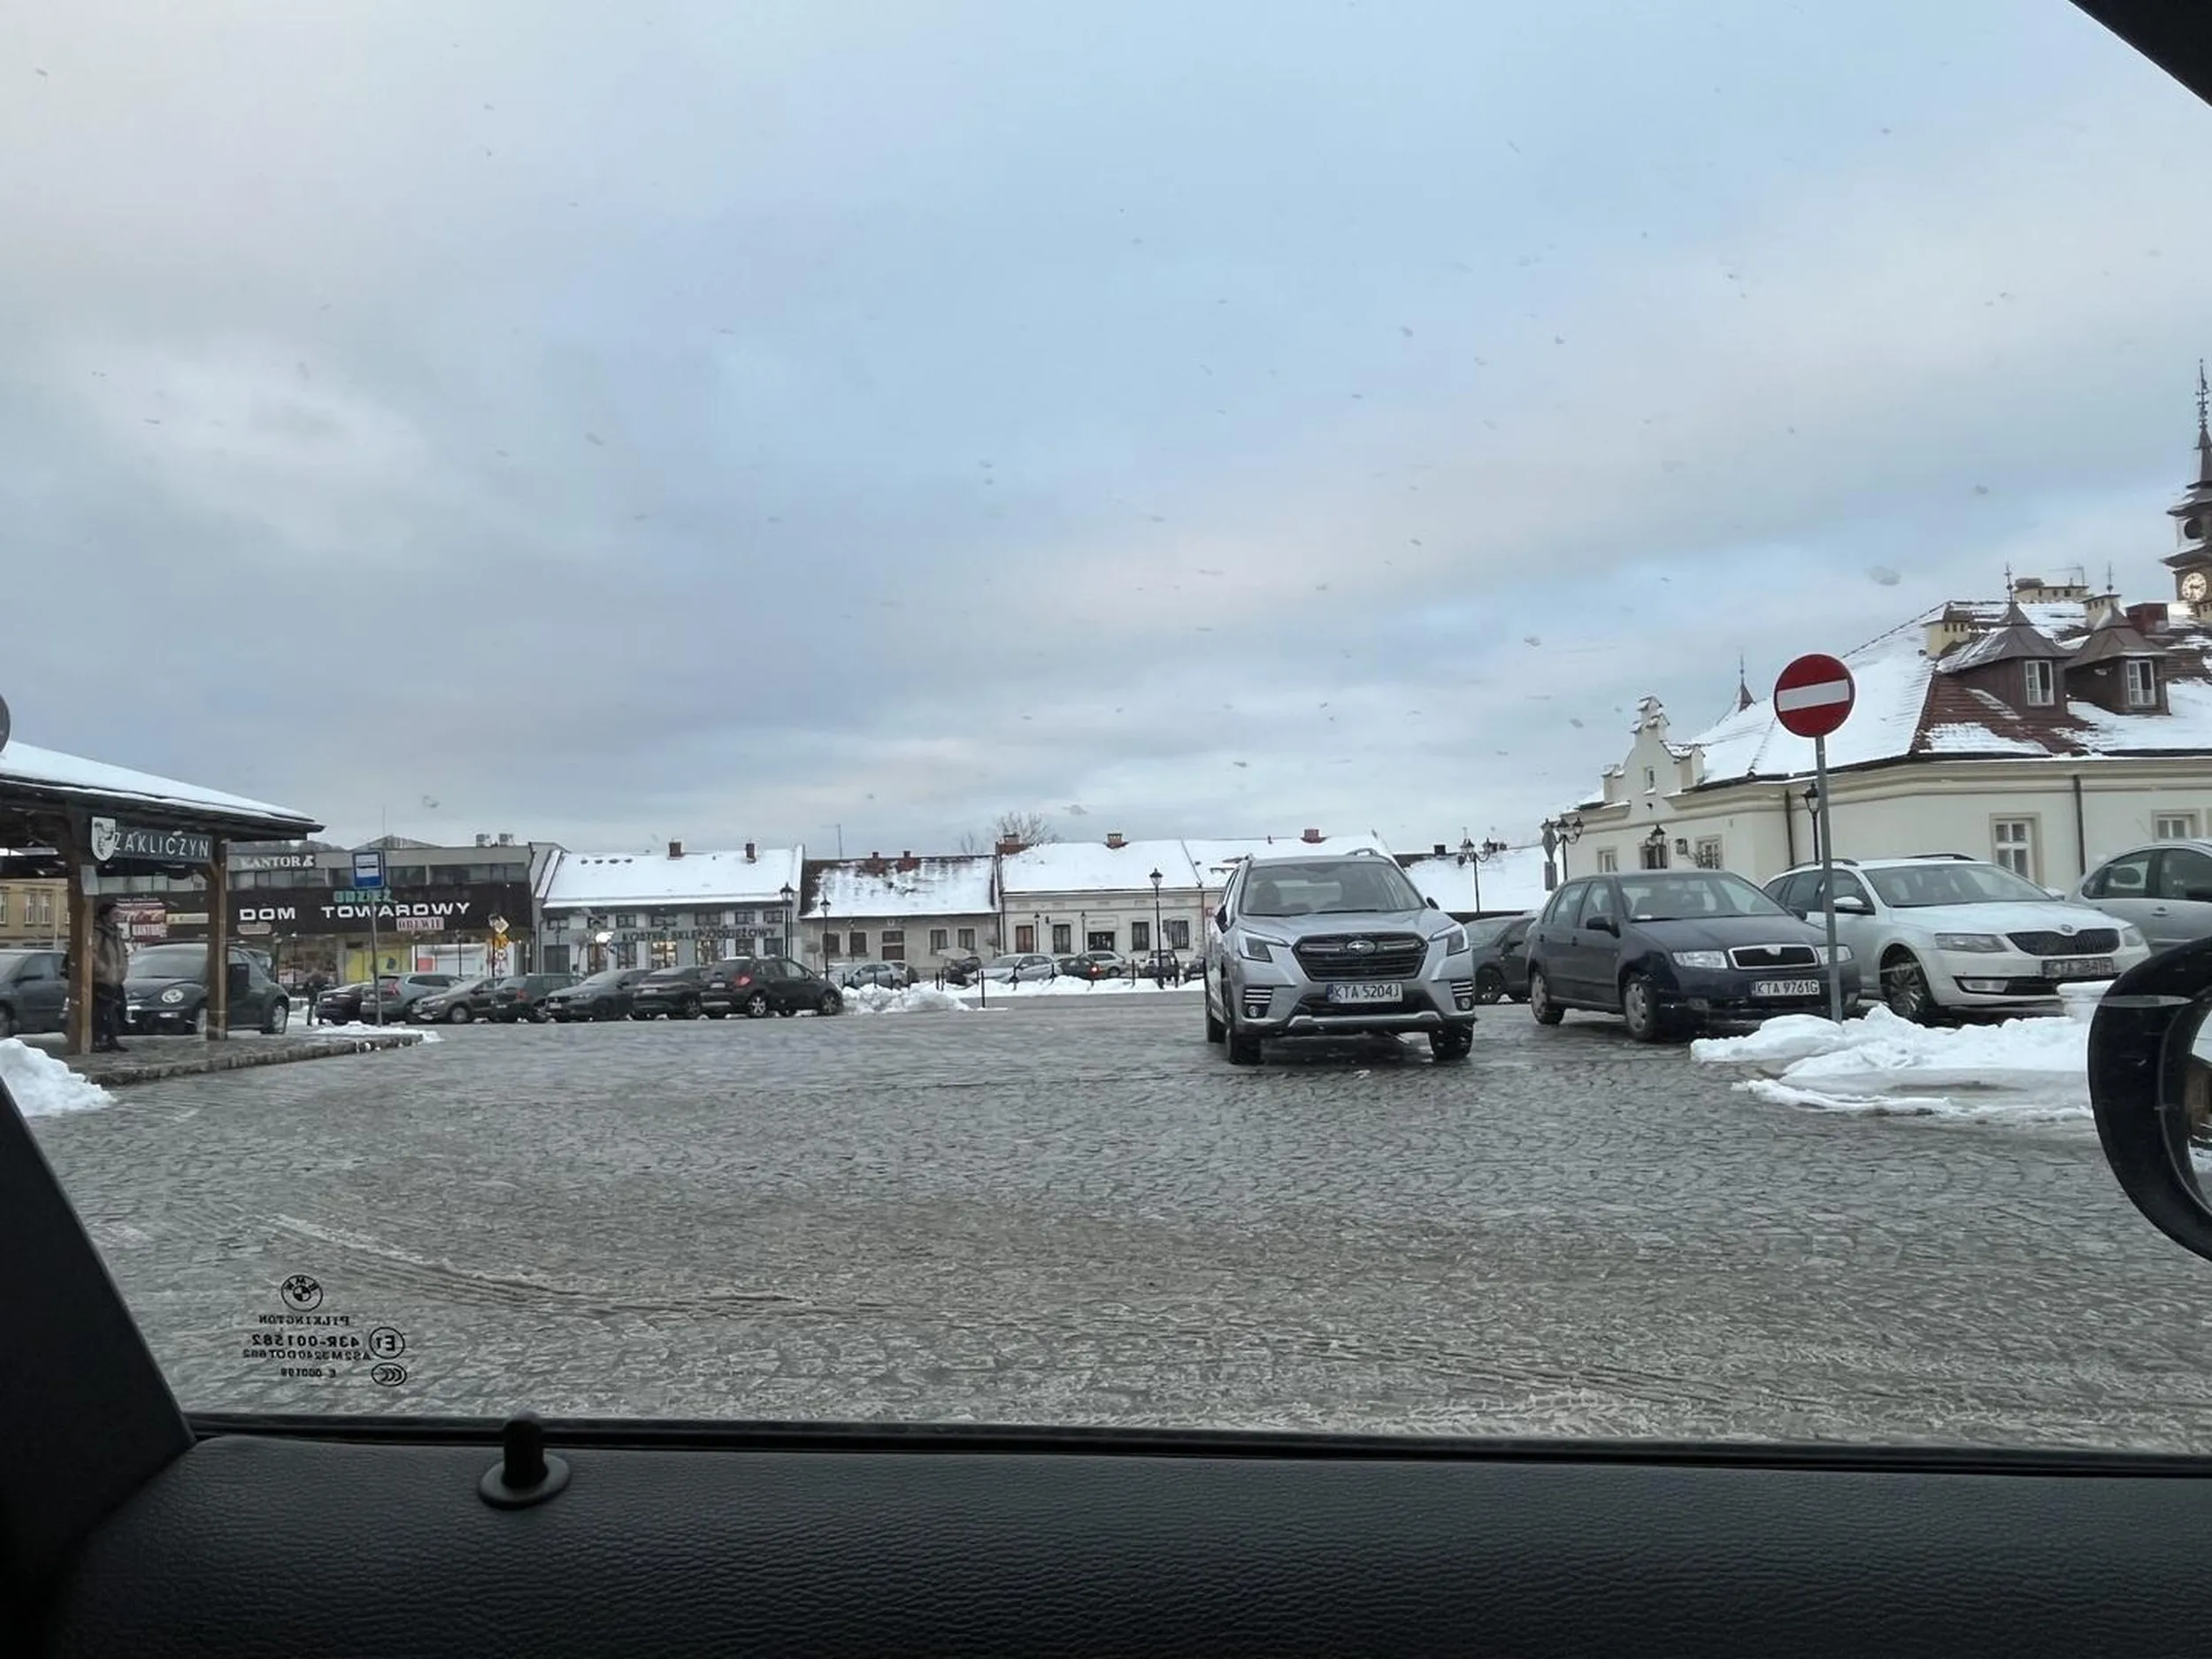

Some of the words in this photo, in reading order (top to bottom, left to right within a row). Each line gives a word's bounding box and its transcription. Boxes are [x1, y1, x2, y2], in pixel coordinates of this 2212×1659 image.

[113, 831, 209, 857] ZAKLICZYN
[241, 856, 301, 869] KANTOR
[240, 908, 296, 921] DOM
[321, 902, 470, 918] TOWAROWY
[1333, 986, 1359, 999] KTA
[1363, 984, 1399, 998] 5204J
[1756, 983, 1780, 995] KTA
